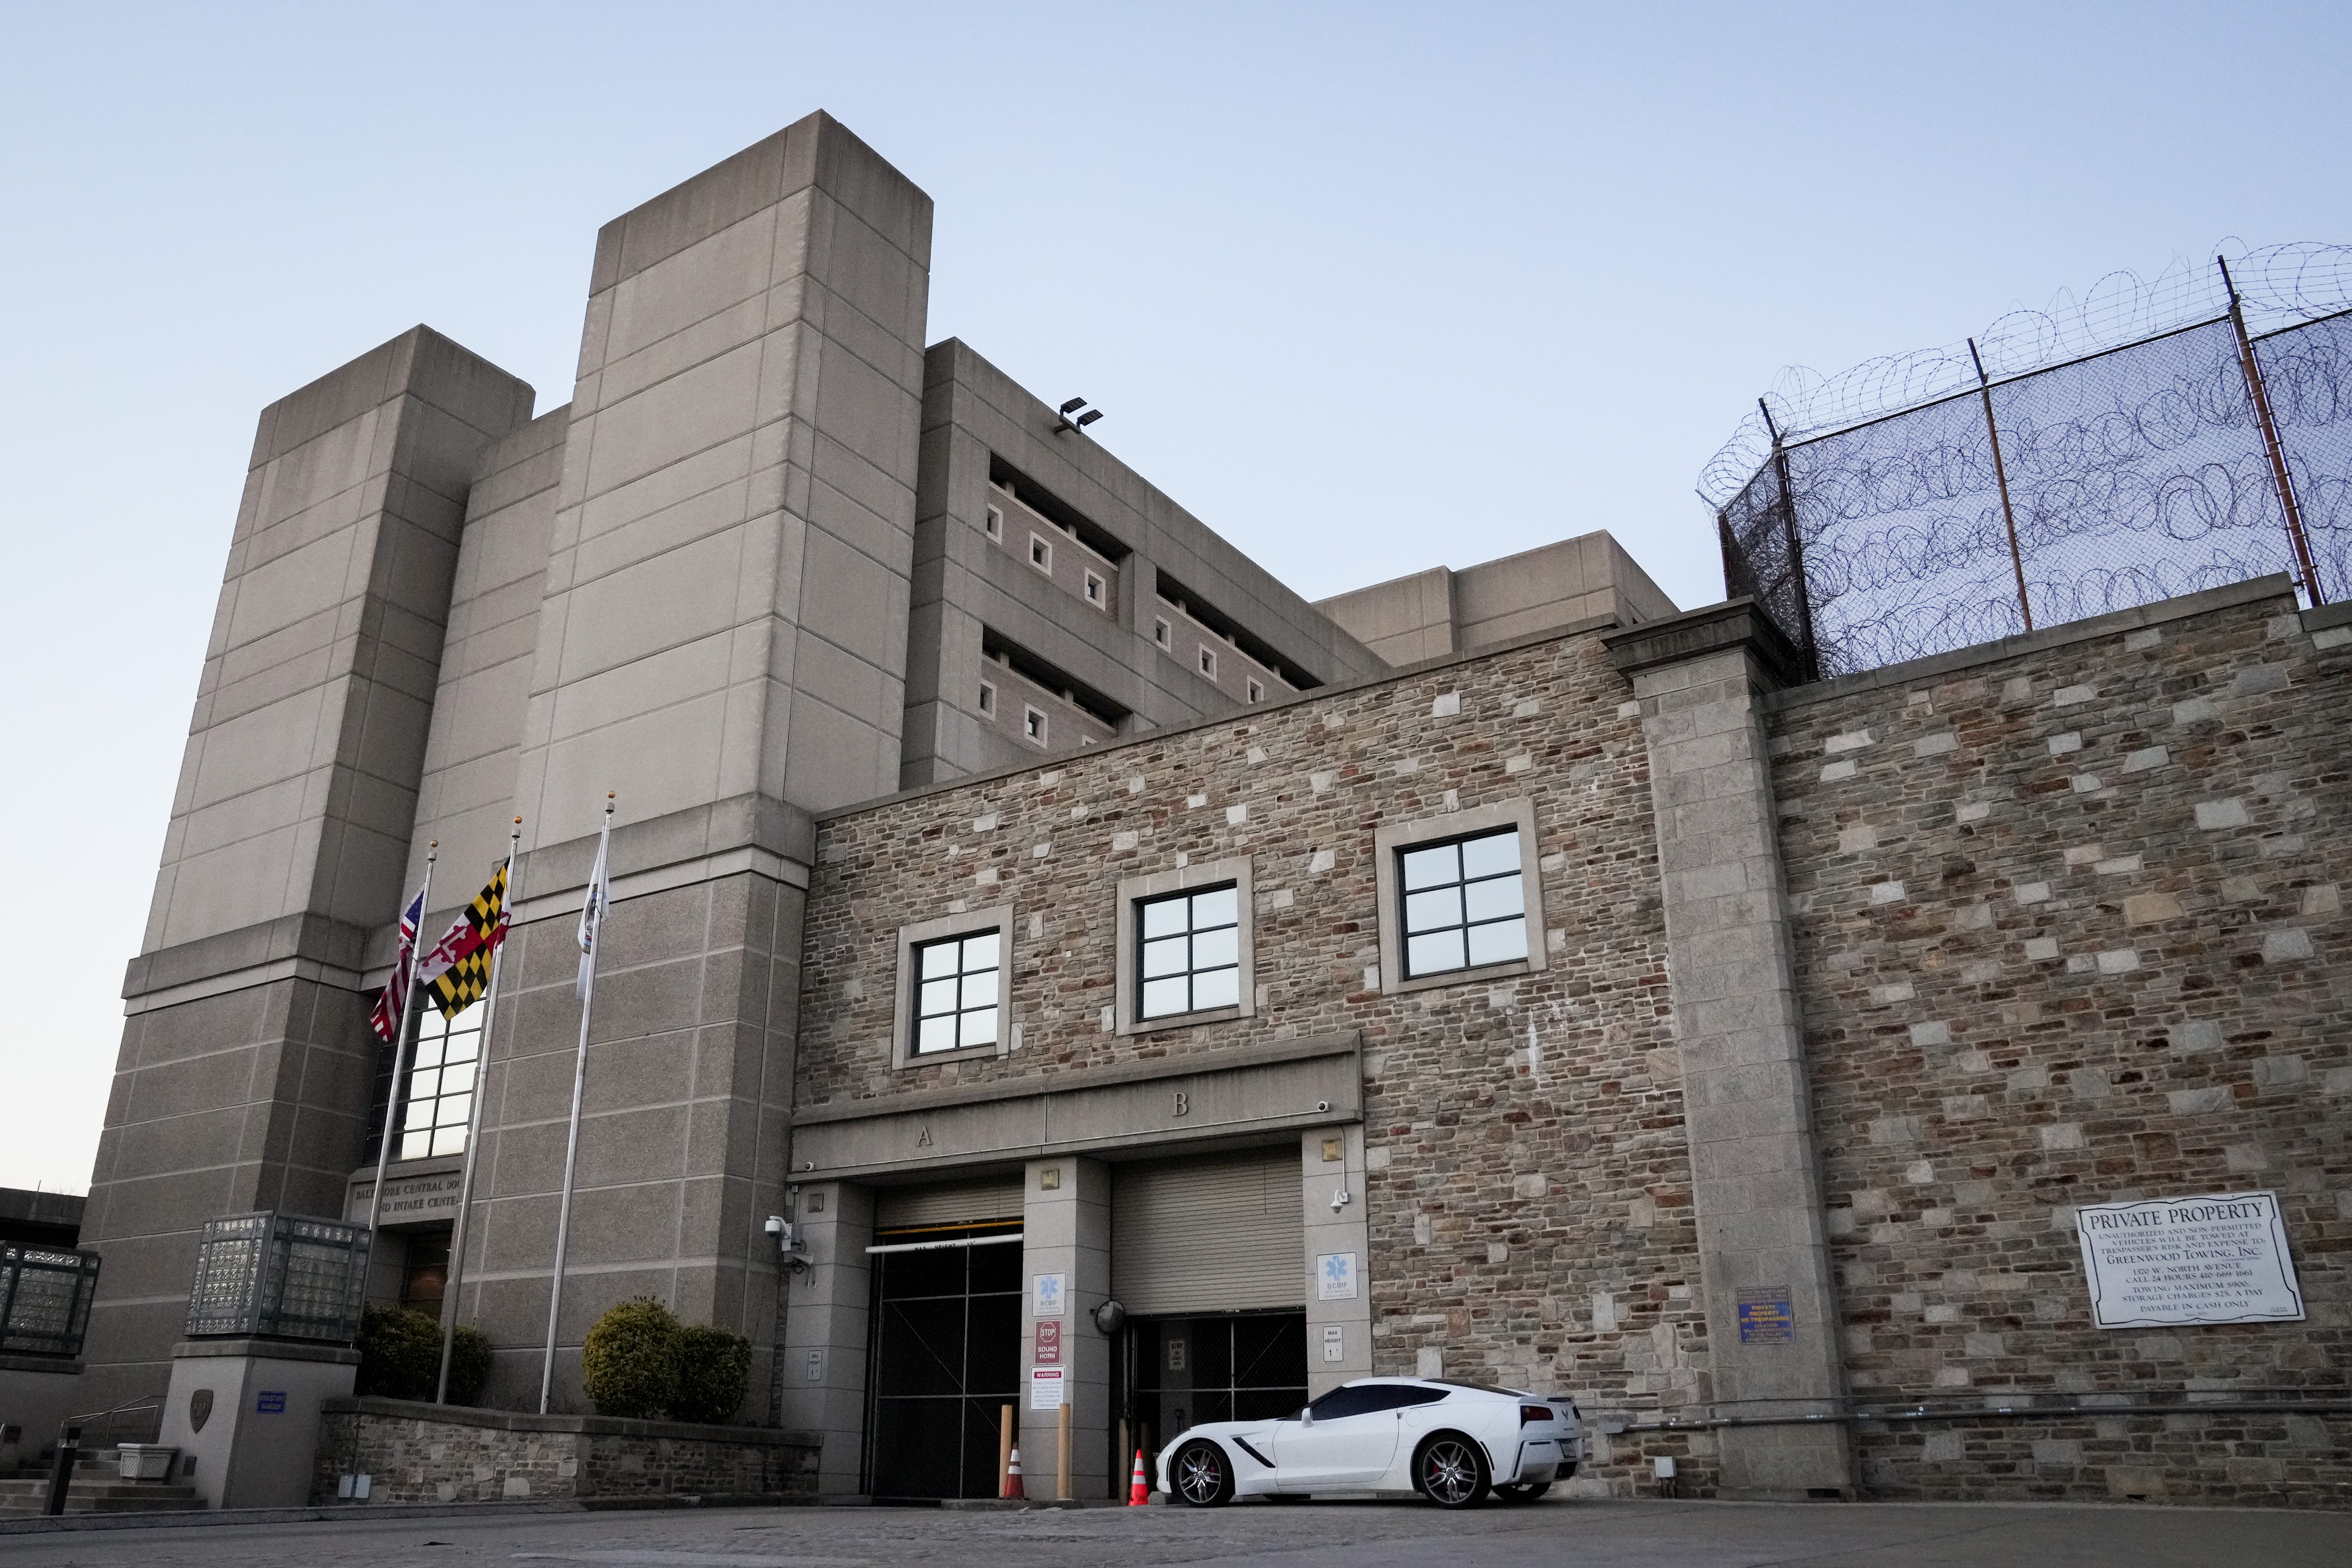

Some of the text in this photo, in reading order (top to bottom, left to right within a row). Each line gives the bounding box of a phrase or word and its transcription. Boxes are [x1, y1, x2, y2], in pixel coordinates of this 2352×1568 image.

[1172, 1092, 1188, 1116] B
[917, 1125, 933, 1146] A
[356, 1186, 400, 1200] BALTORE
[404, 1181, 442, 1195] CENTRAL
[379, 1203, 391, 1212] ND
[393, 1199, 424, 1211] INTAKE
[2089, 1202, 2262, 1230] PRIVATE PROPERTY
[2098, 1230, 2164, 1239] UNAUTHORIZED
[2211, 1223, 2261, 1232] PERMITTED
[2201, 1232, 2235, 1240] TOWED
[2102, 1245, 2158, 1254] TRESPASSER'S
[2204, 1262, 2242, 1271] AVENUE
[2164, 1273, 2197, 1282] HOURS
[2174, 1283, 2224, 1291] MAXIMUM
[2122, 1293, 2164, 1302] STORAGE
[2167, 1291, 2211, 1300] CHARGES
[2140, 1304, 2179, 1312] PAYABLE
[2196, 1301, 2222, 1309] CASH
